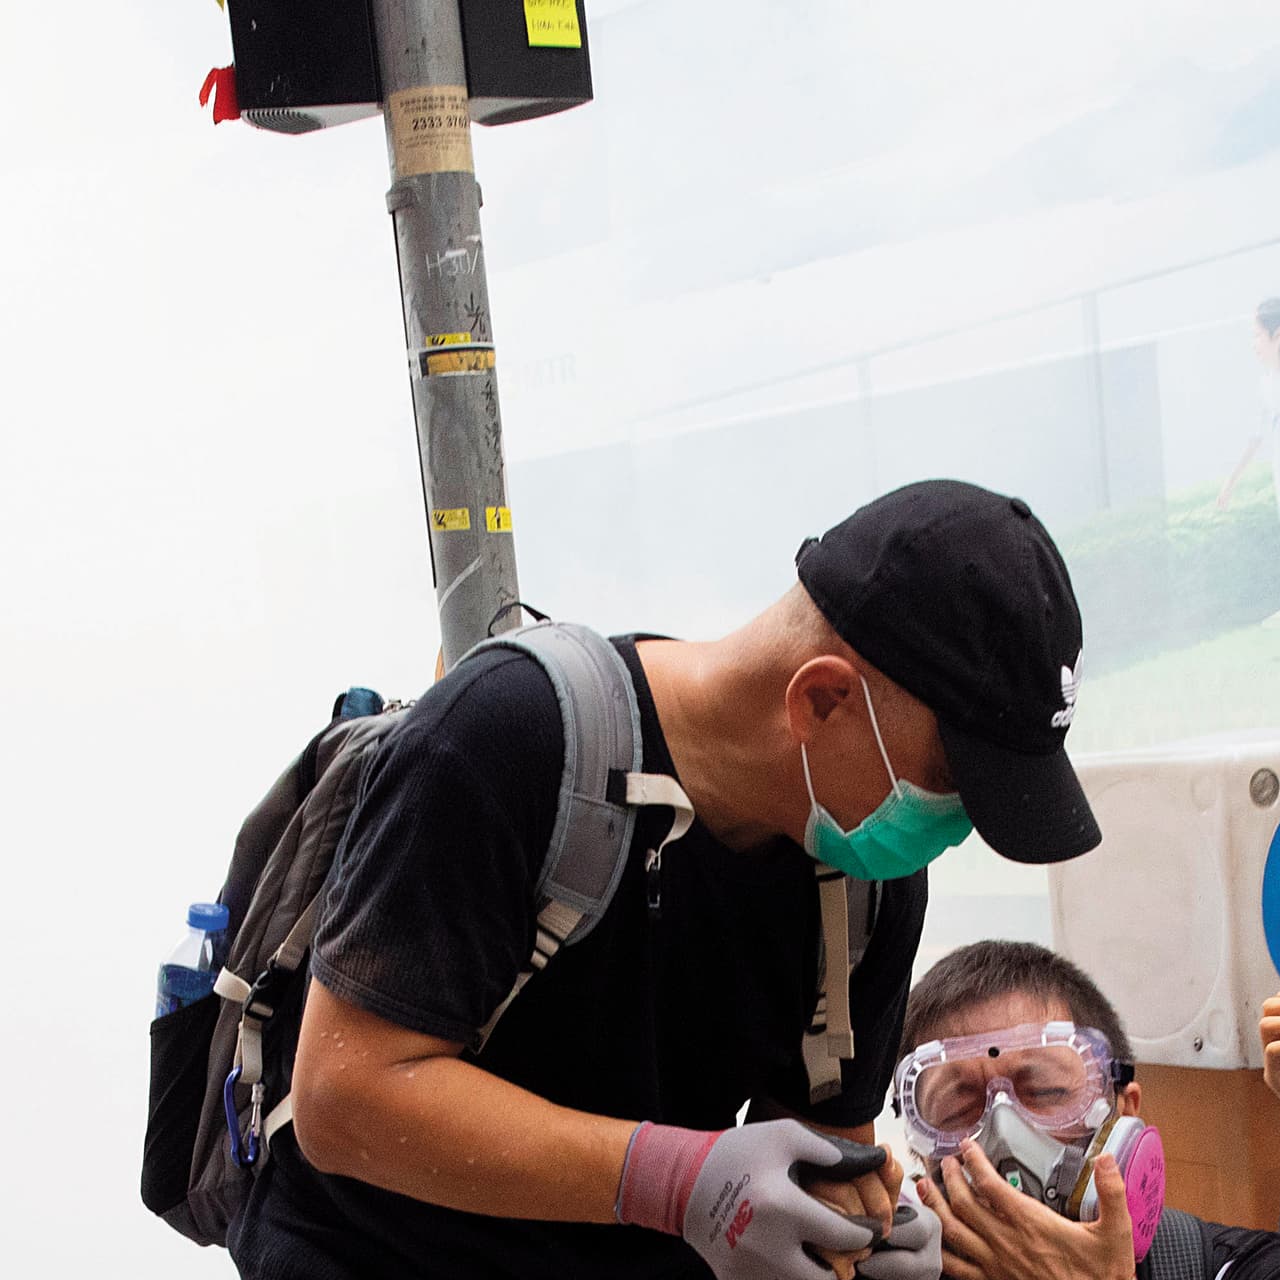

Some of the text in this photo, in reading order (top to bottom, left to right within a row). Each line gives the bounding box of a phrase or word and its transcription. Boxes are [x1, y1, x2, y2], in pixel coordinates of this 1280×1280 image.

[709, 1180, 733, 1219] Gloves
[719, 1173, 751, 1222] Comfort
[725, 1199, 754, 1249] 3M
